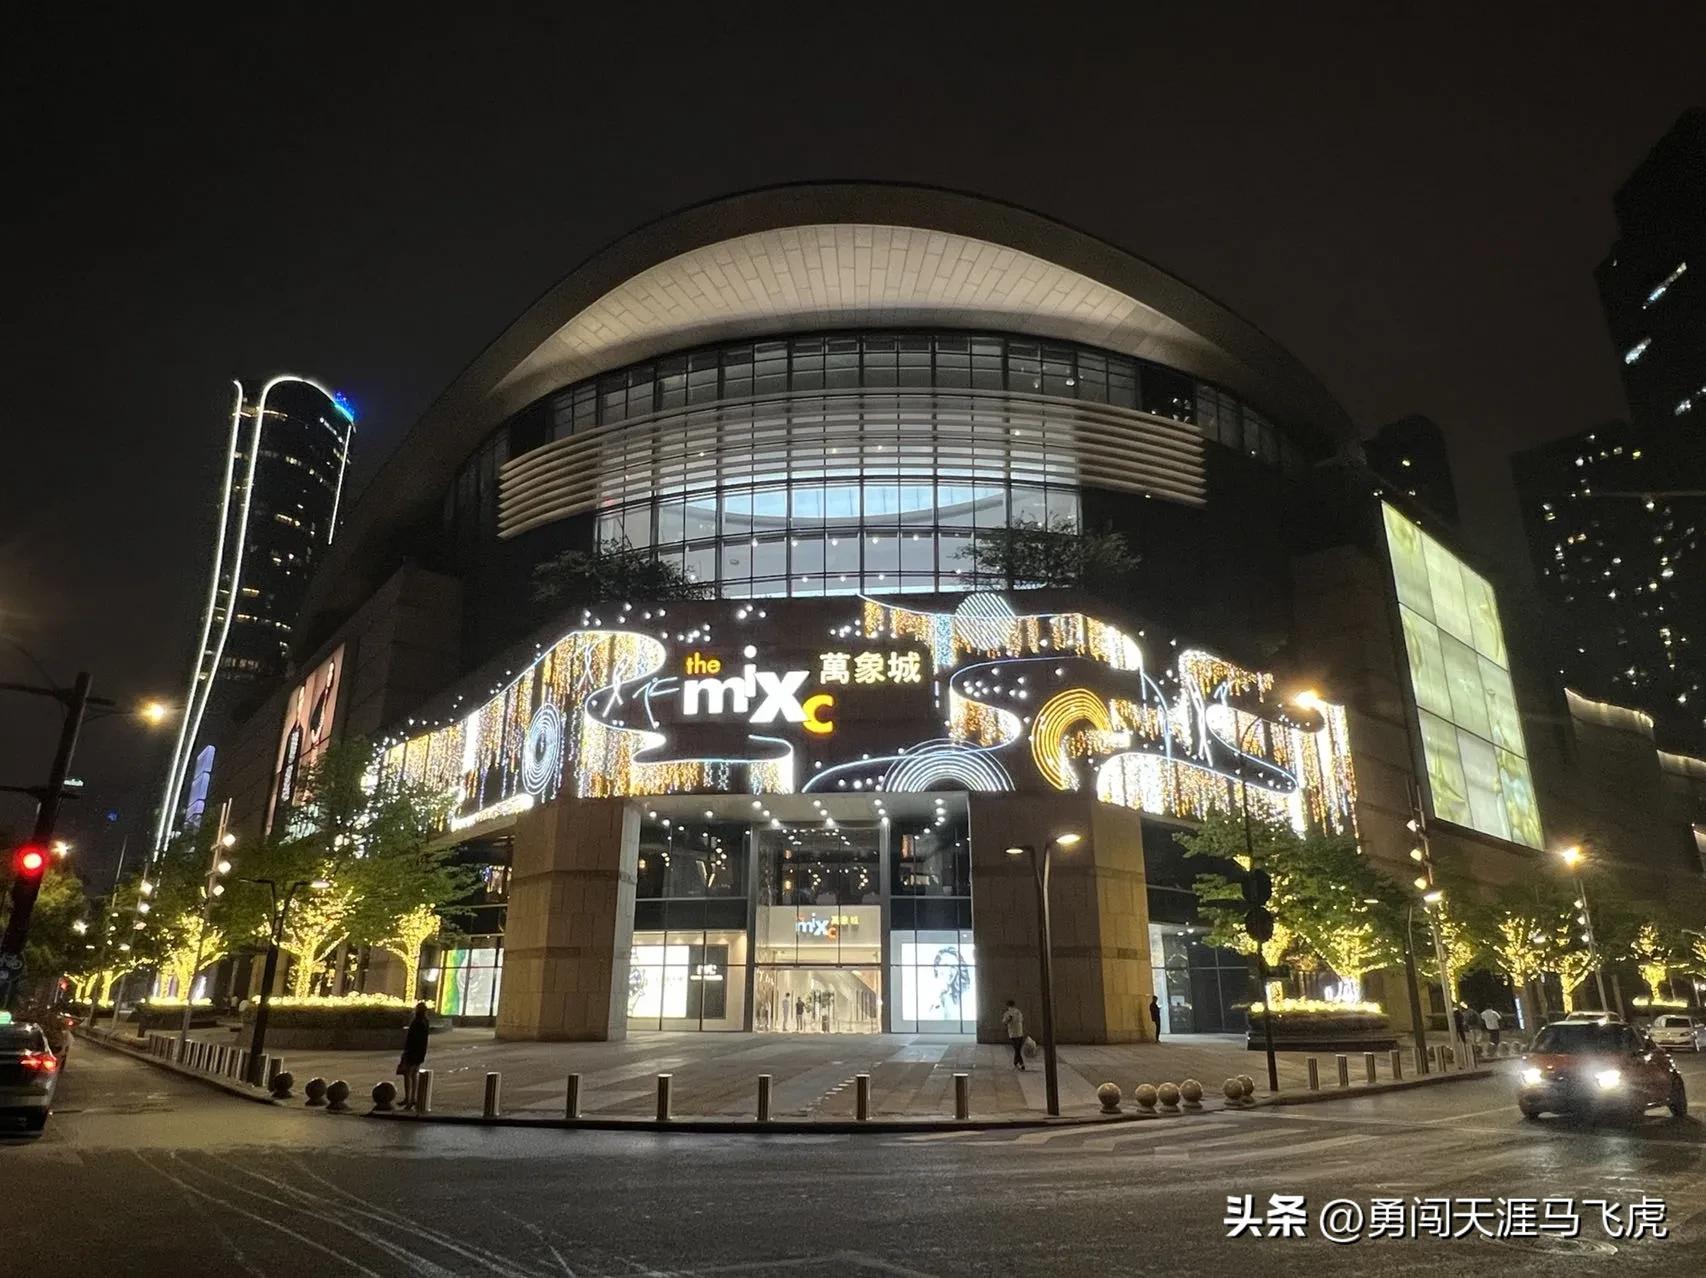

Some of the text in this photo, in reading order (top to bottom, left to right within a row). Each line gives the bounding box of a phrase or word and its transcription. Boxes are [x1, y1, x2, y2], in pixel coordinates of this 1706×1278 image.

[685, 652, 721, 675] the
[819, 651, 921, 684] 萬象城
